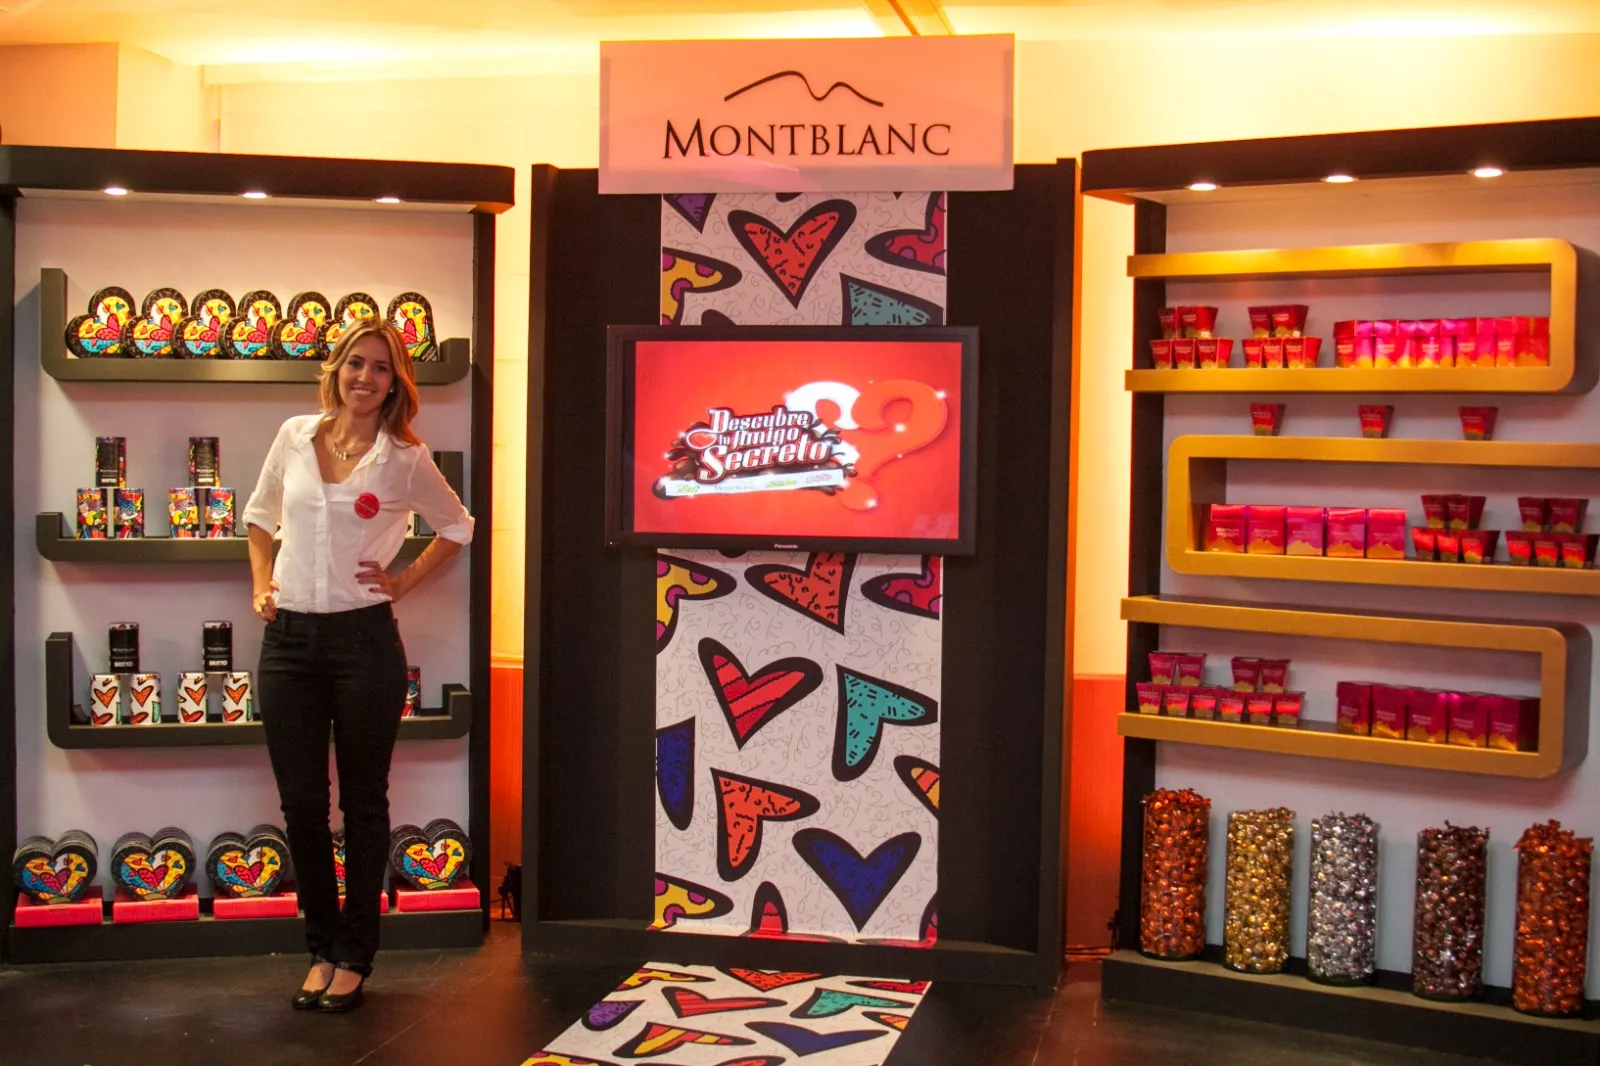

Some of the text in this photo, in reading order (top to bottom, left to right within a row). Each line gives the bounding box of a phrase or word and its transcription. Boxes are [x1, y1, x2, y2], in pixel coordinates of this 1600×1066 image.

[662, 117, 951, 159] MONTBLANC
[708, 406, 809, 434] Descubre
[731, 427, 799, 449] Amigo
[699, 433, 828, 481] Secreto
